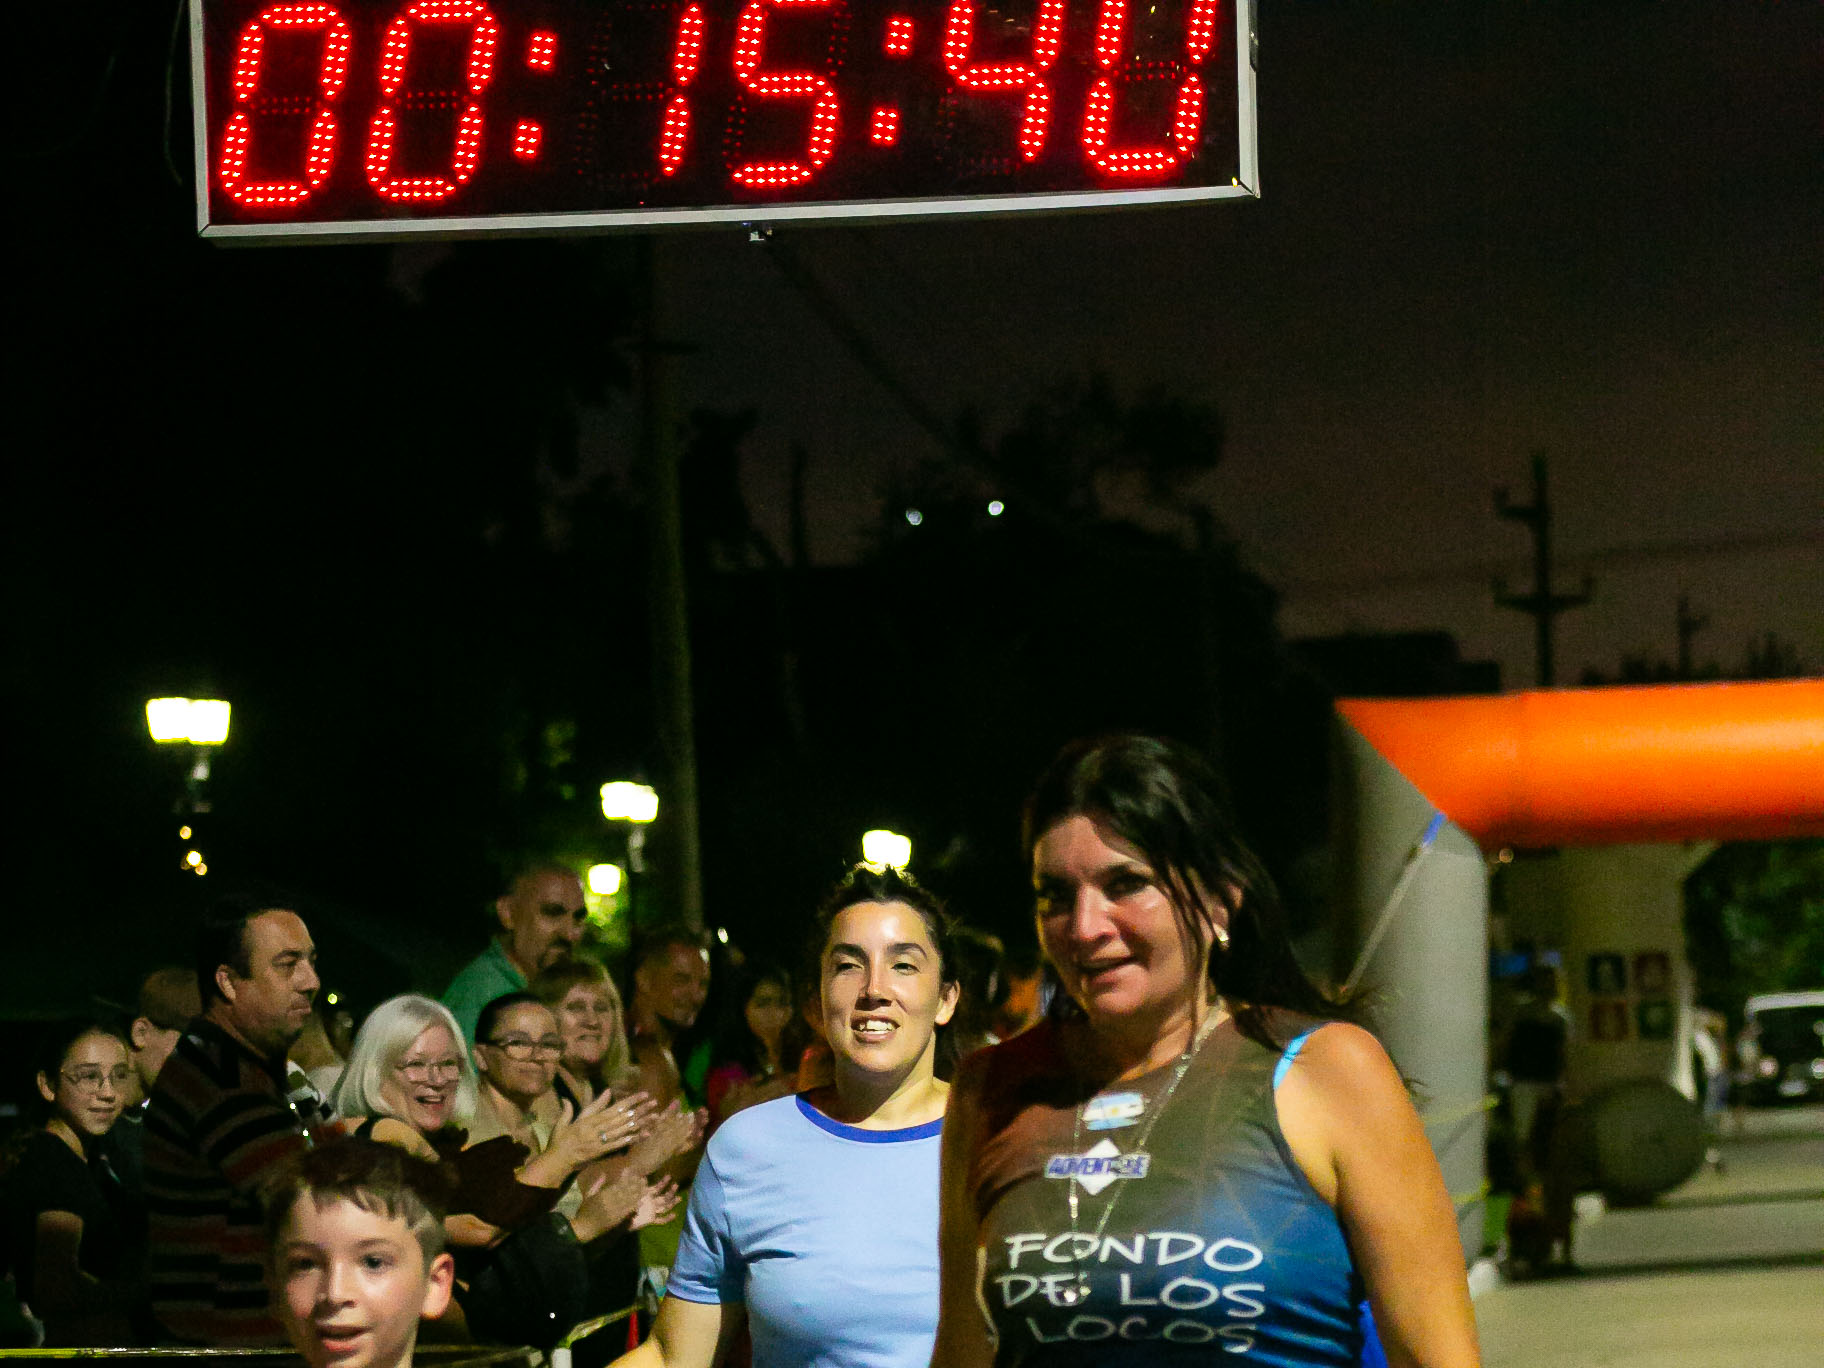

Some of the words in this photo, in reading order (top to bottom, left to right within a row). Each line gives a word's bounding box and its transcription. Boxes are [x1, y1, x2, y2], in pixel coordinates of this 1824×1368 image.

[219, 0, 1217, 204] 00:15:40
[1004, 1231, 1264, 1272] FONDO
[995, 1273, 1081, 1308] DE
[1120, 1273, 1266, 1318] LOS
[1026, 1314, 1258, 1354] LOCOS
